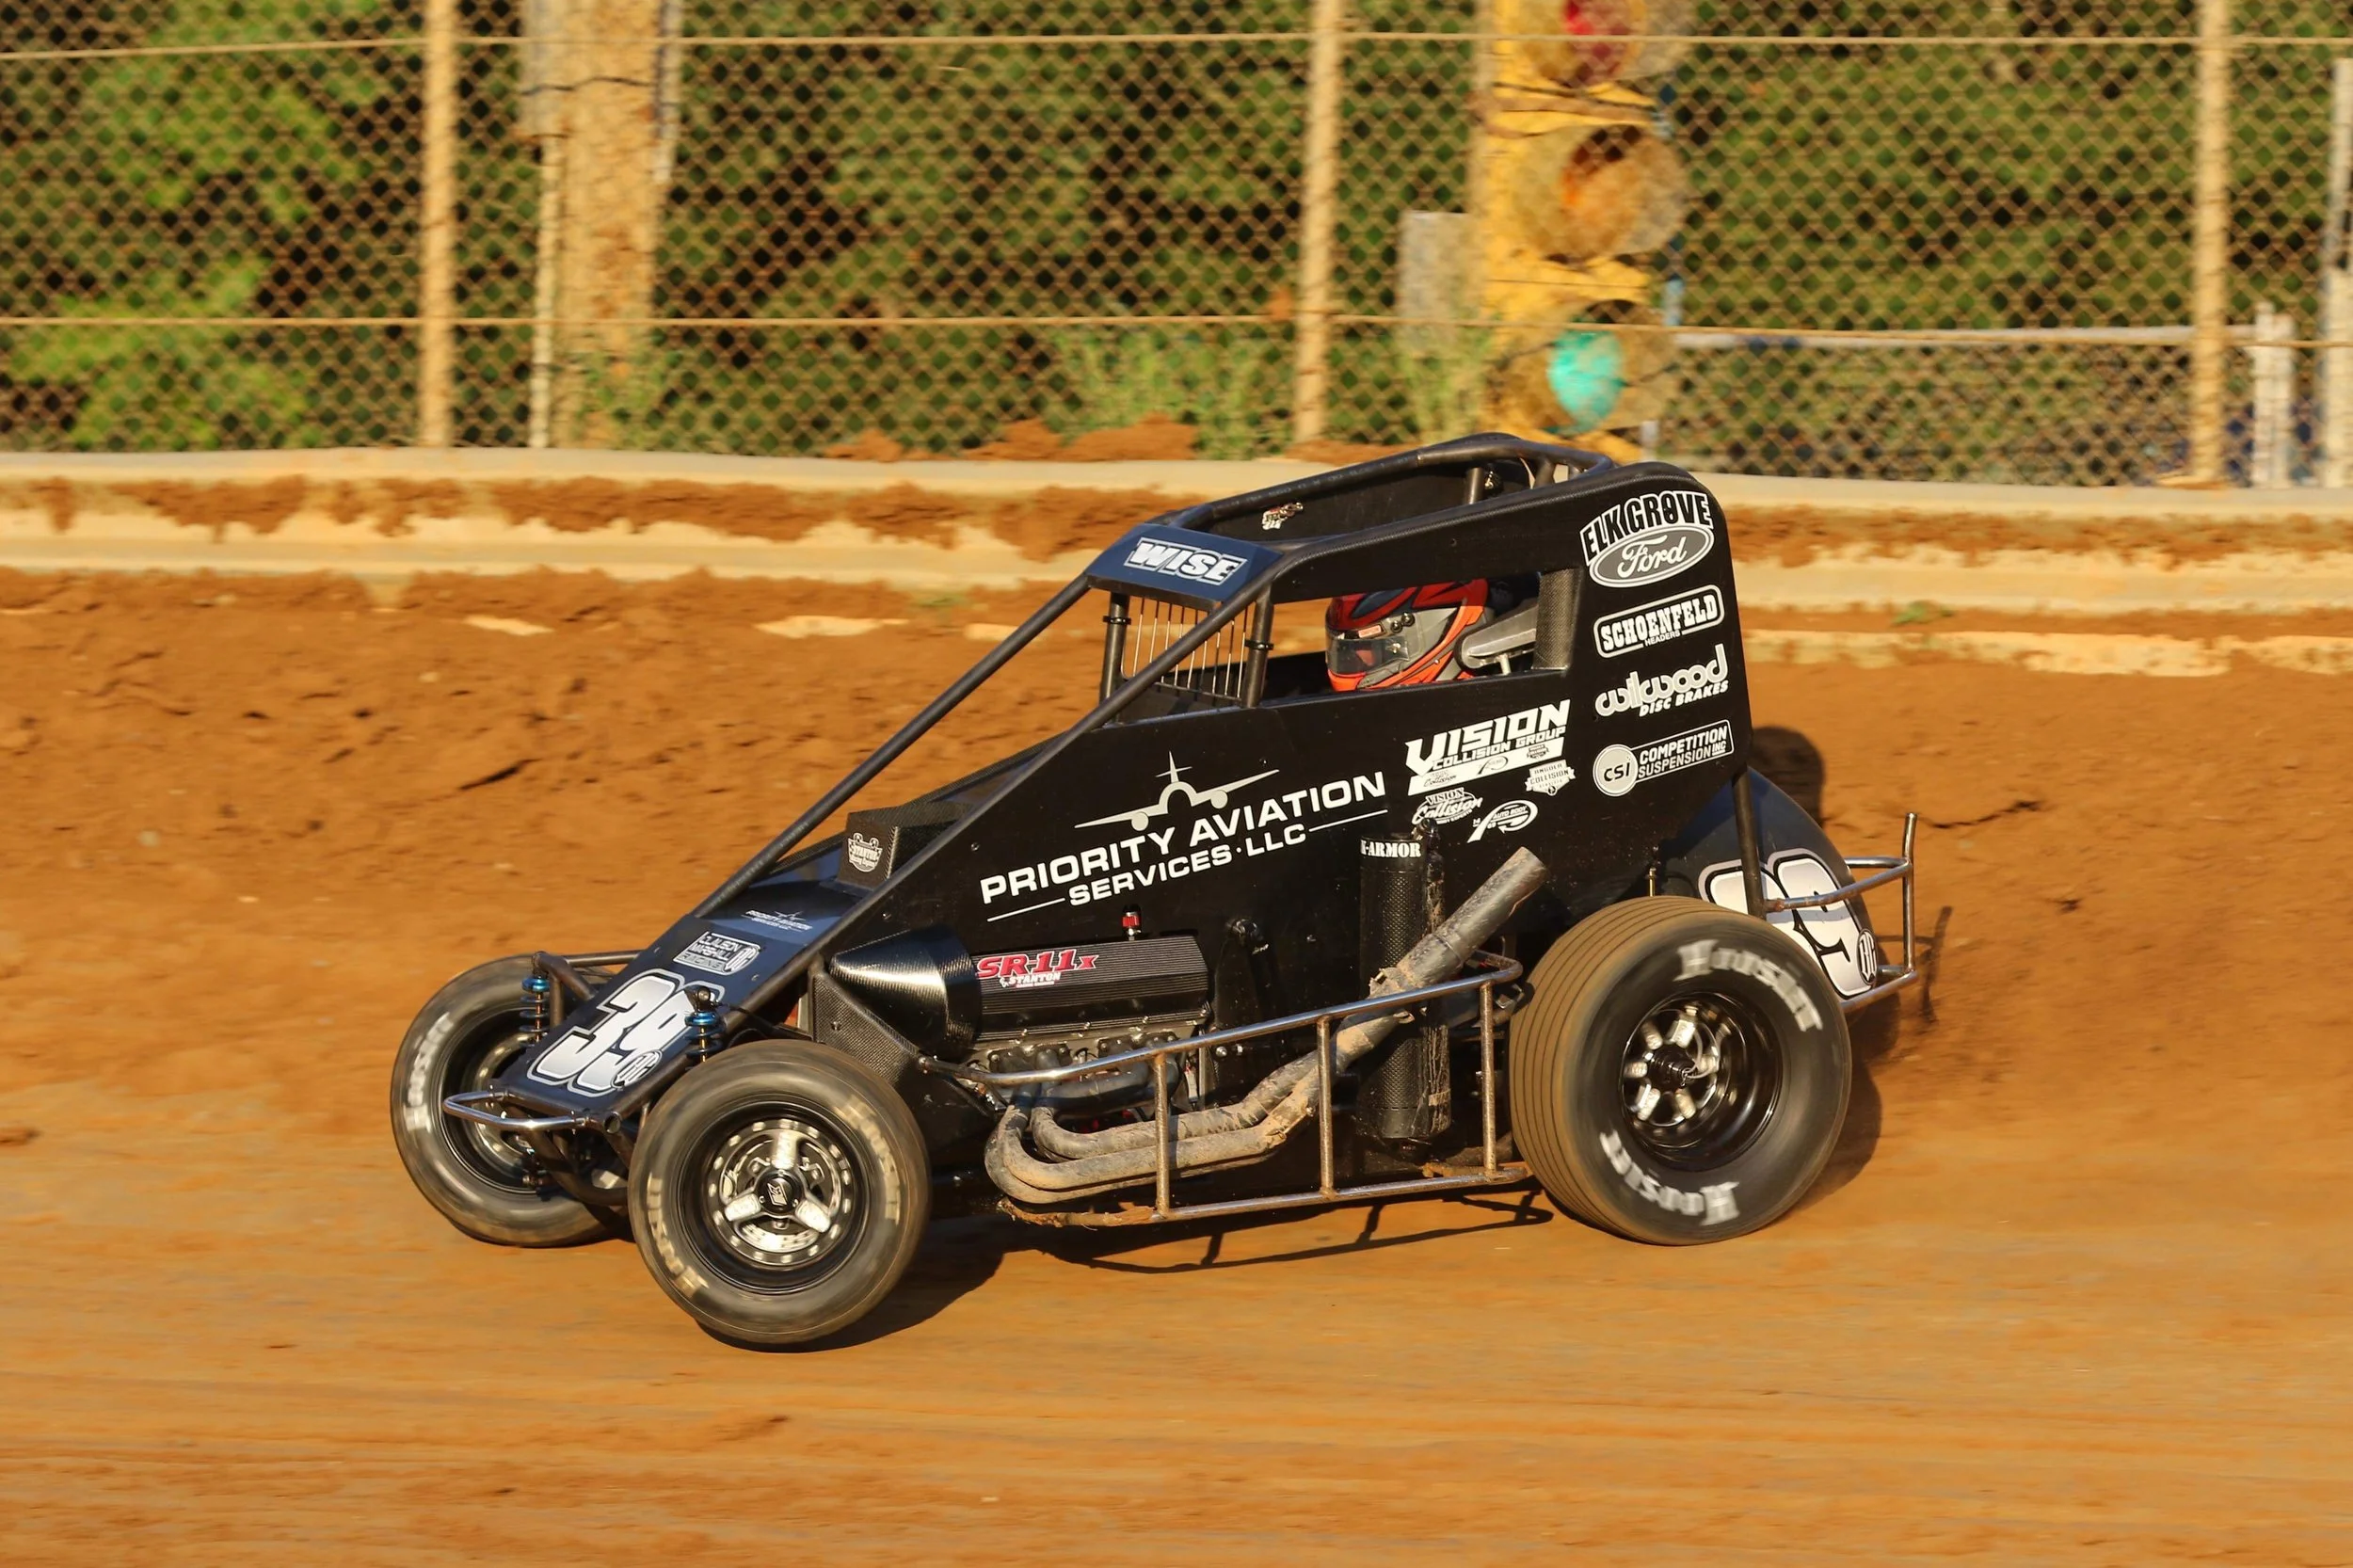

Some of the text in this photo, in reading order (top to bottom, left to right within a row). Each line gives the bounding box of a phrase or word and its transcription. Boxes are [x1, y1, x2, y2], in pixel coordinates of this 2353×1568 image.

[1127, 540, 1244, 584] WISE
[1617, 535, 1688, 578] Ford
[1600, 594, 1718, 651] SCHOENFELD
[1644, 630, 1681, 647] HEADERS
[1594, 643, 1729, 717] wilwood
[1640, 680, 1729, 717] DISC BRAKES
[1405, 699, 1571, 776] VISION
[1433, 740, 1512, 771] COLLISION
[1514, 726, 1566, 749] GROUP
[1640, 725, 1728, 765] COMPETITION
[1712, 740, 1727, 752] INC
[1604, 762, 1630, 782] CSI
[1638, 744, 1712, 778] SUSPENSION
[1426, 788, 1465, 805] VISION
[979, 771, 1387, 904] PRIORITY AVIATION
[1008, 972, 1062, 985] STANTON
[529, 969, 724, 1096] 39
